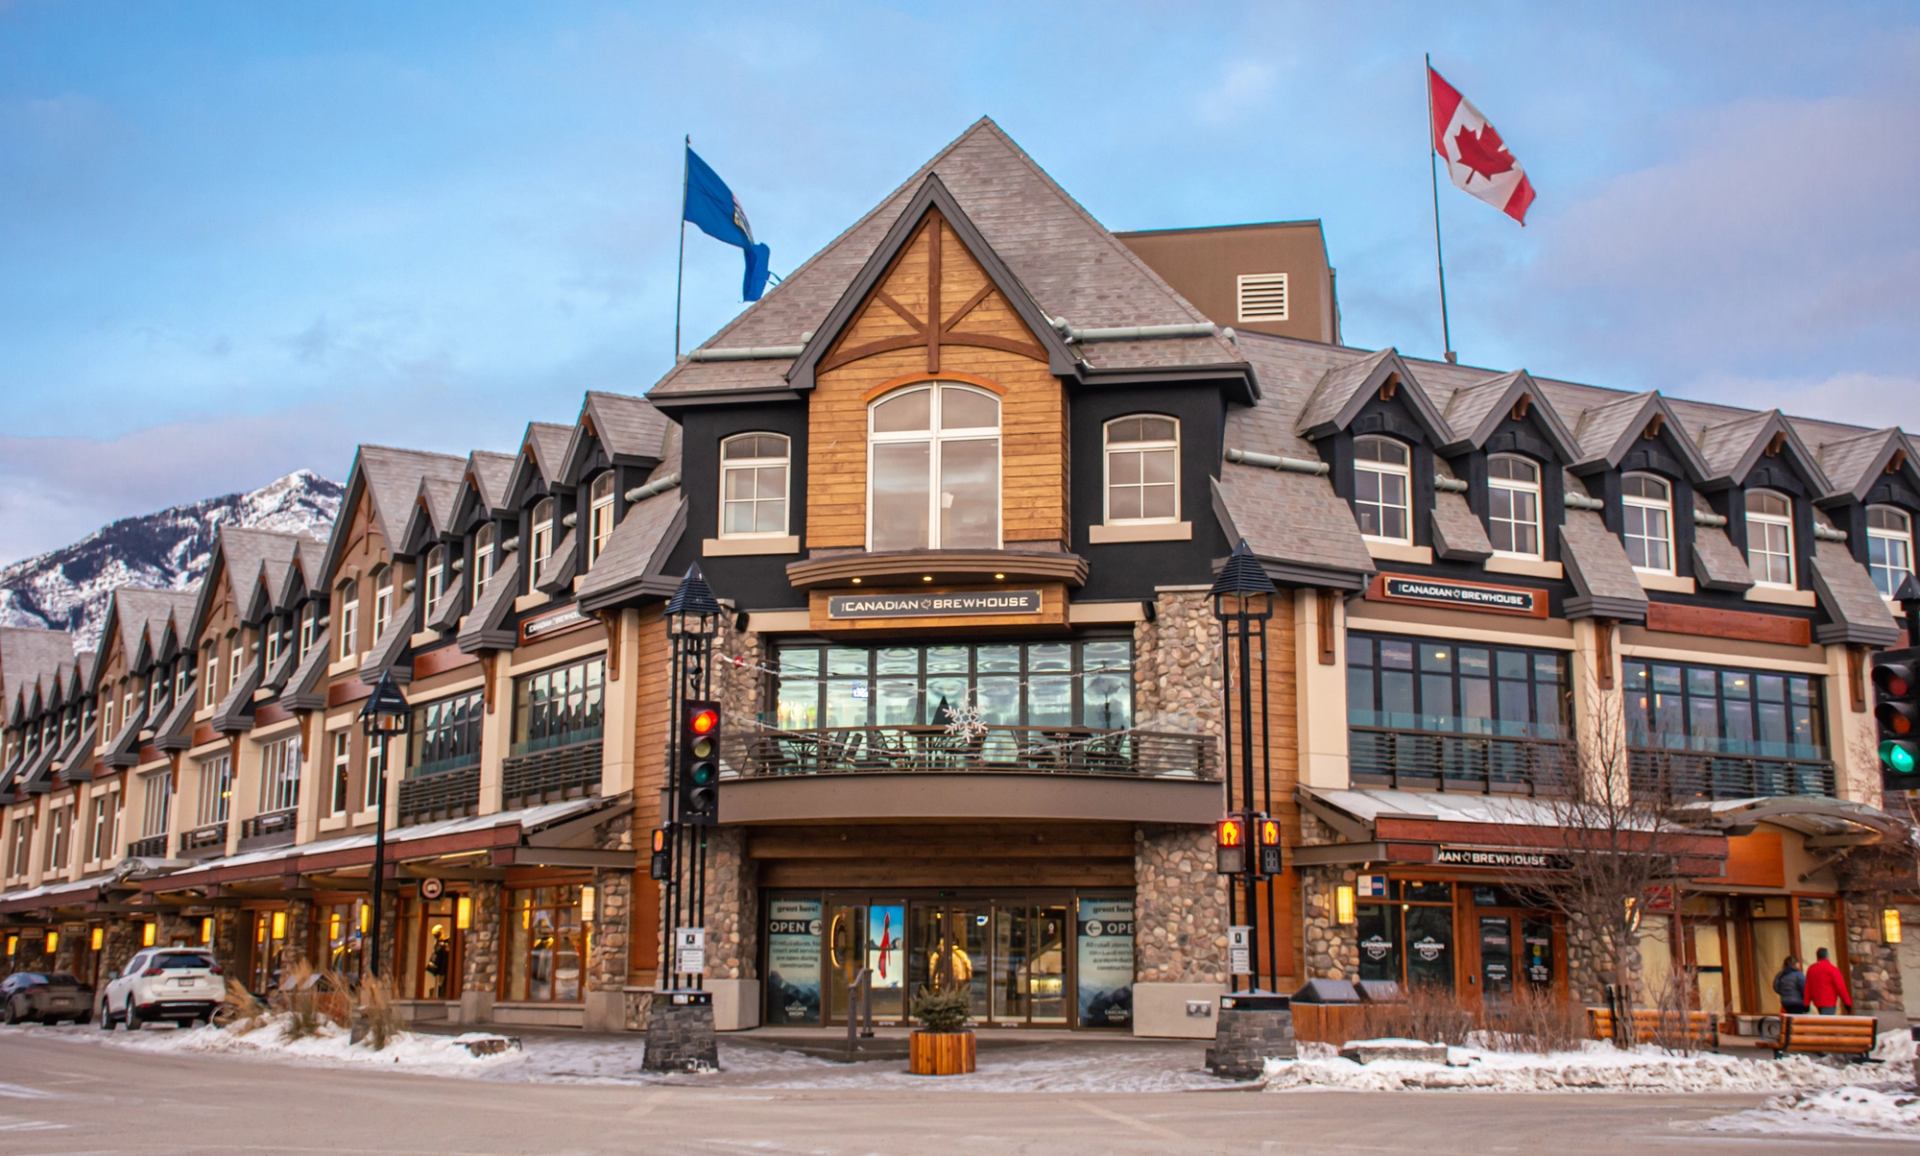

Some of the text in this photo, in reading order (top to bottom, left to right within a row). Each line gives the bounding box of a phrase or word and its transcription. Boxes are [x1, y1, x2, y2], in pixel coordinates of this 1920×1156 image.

[1401, 584, 1453, 597] CANADIAN
[1461, 590, 1524, 605] BREWHOUSE
[845, 600, 919, 612] CANADIAN
[933, 597, 1029, 609] BREWHOUSE
[1472, 853, 1546, 866] BREWHOUSE
[770, 921, 806, 933] OPEN
[1107, 922, 1134, 934] OPE
